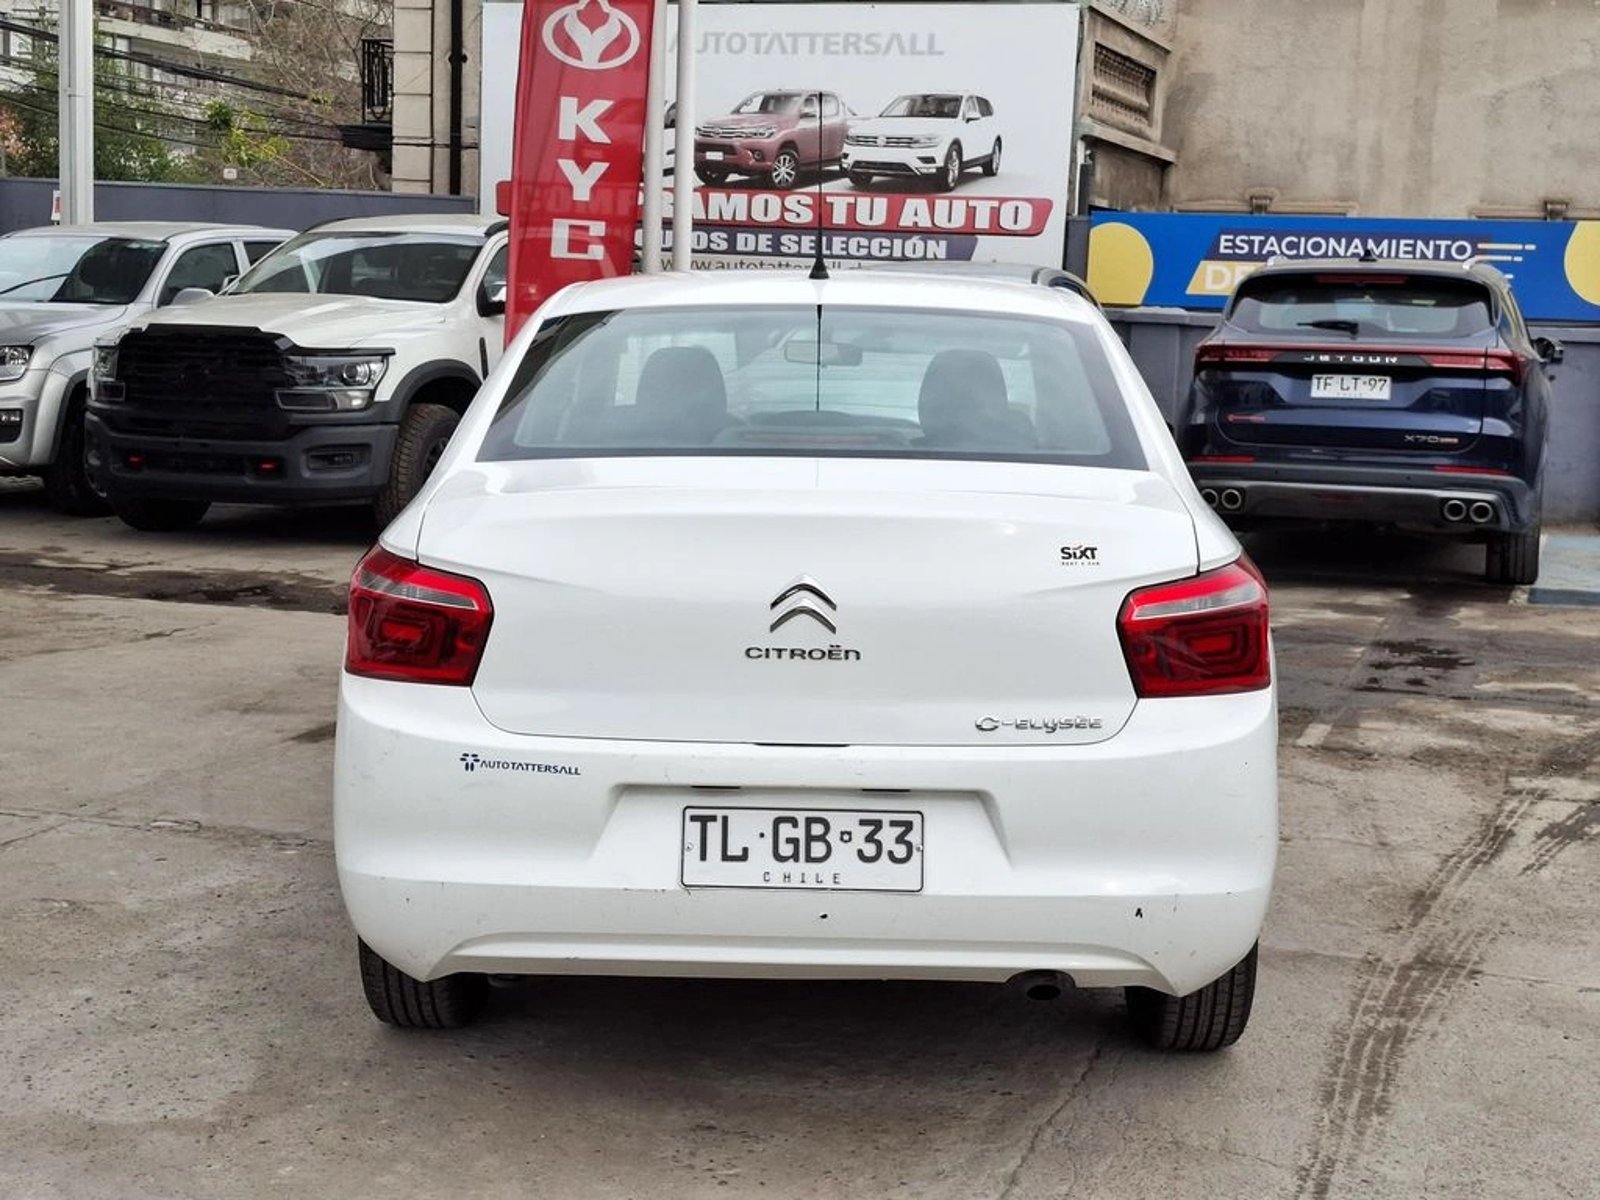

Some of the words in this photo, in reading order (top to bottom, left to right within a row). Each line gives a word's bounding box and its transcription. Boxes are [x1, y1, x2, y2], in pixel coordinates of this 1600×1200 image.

[826, 196, 888, 226] TU
[899, 198, 1034, 231] AUTO
[736, 232, 772, 253] DE
[780, 234, 948, 259] SELECCIÓN
[1219, 234, 1472, 260] ESTACIONAMIENTO
[480, 760, 582, 776] AUTOTATTERSALL
[763, 870, 842, 886] CHILE
